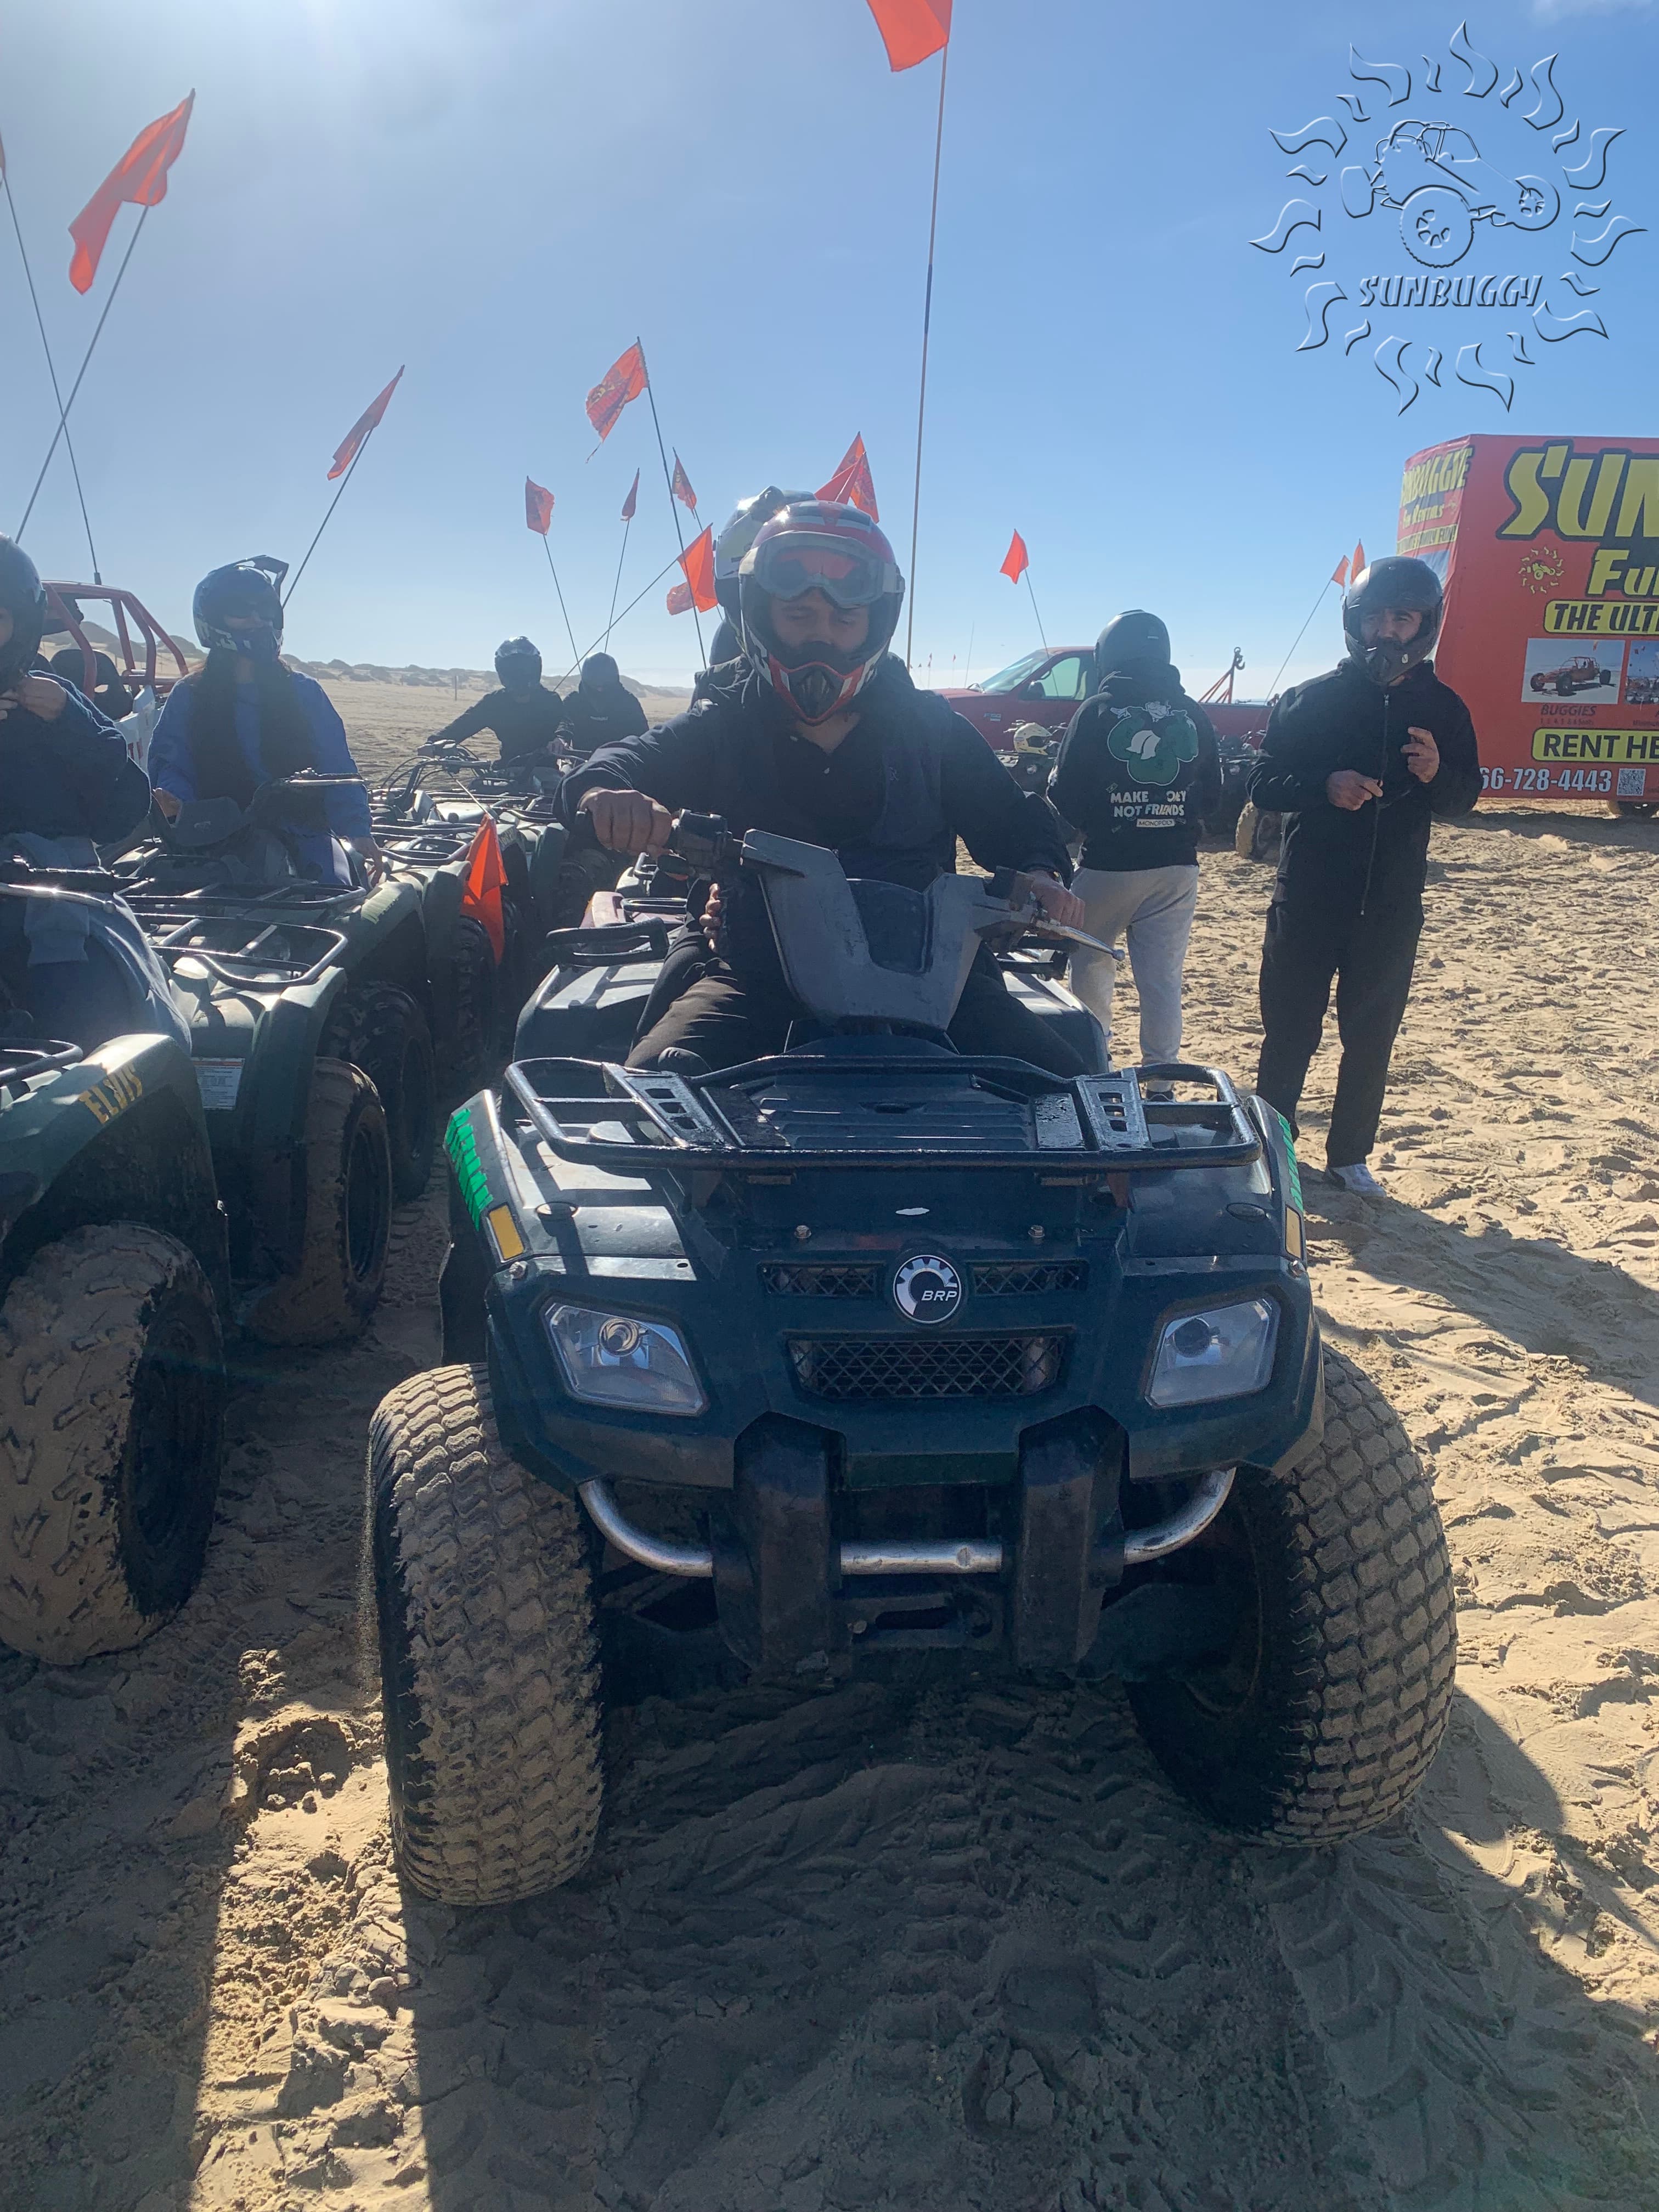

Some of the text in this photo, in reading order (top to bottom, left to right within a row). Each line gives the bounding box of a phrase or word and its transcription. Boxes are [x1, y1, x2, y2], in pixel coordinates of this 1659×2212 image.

[1554, 603, 1604, 630] THE
[1541, 703, 1597, 716] BUGGIES
[1543, 733, 1620, 758] RENT
[1110, 791, 1149, 803] MAKE
[1114, 803, 1185, 817] NOT FRIENDS
[78, 1063, 143, 1124] ELVIS
[921, 1290, 957, 1301] BRP
